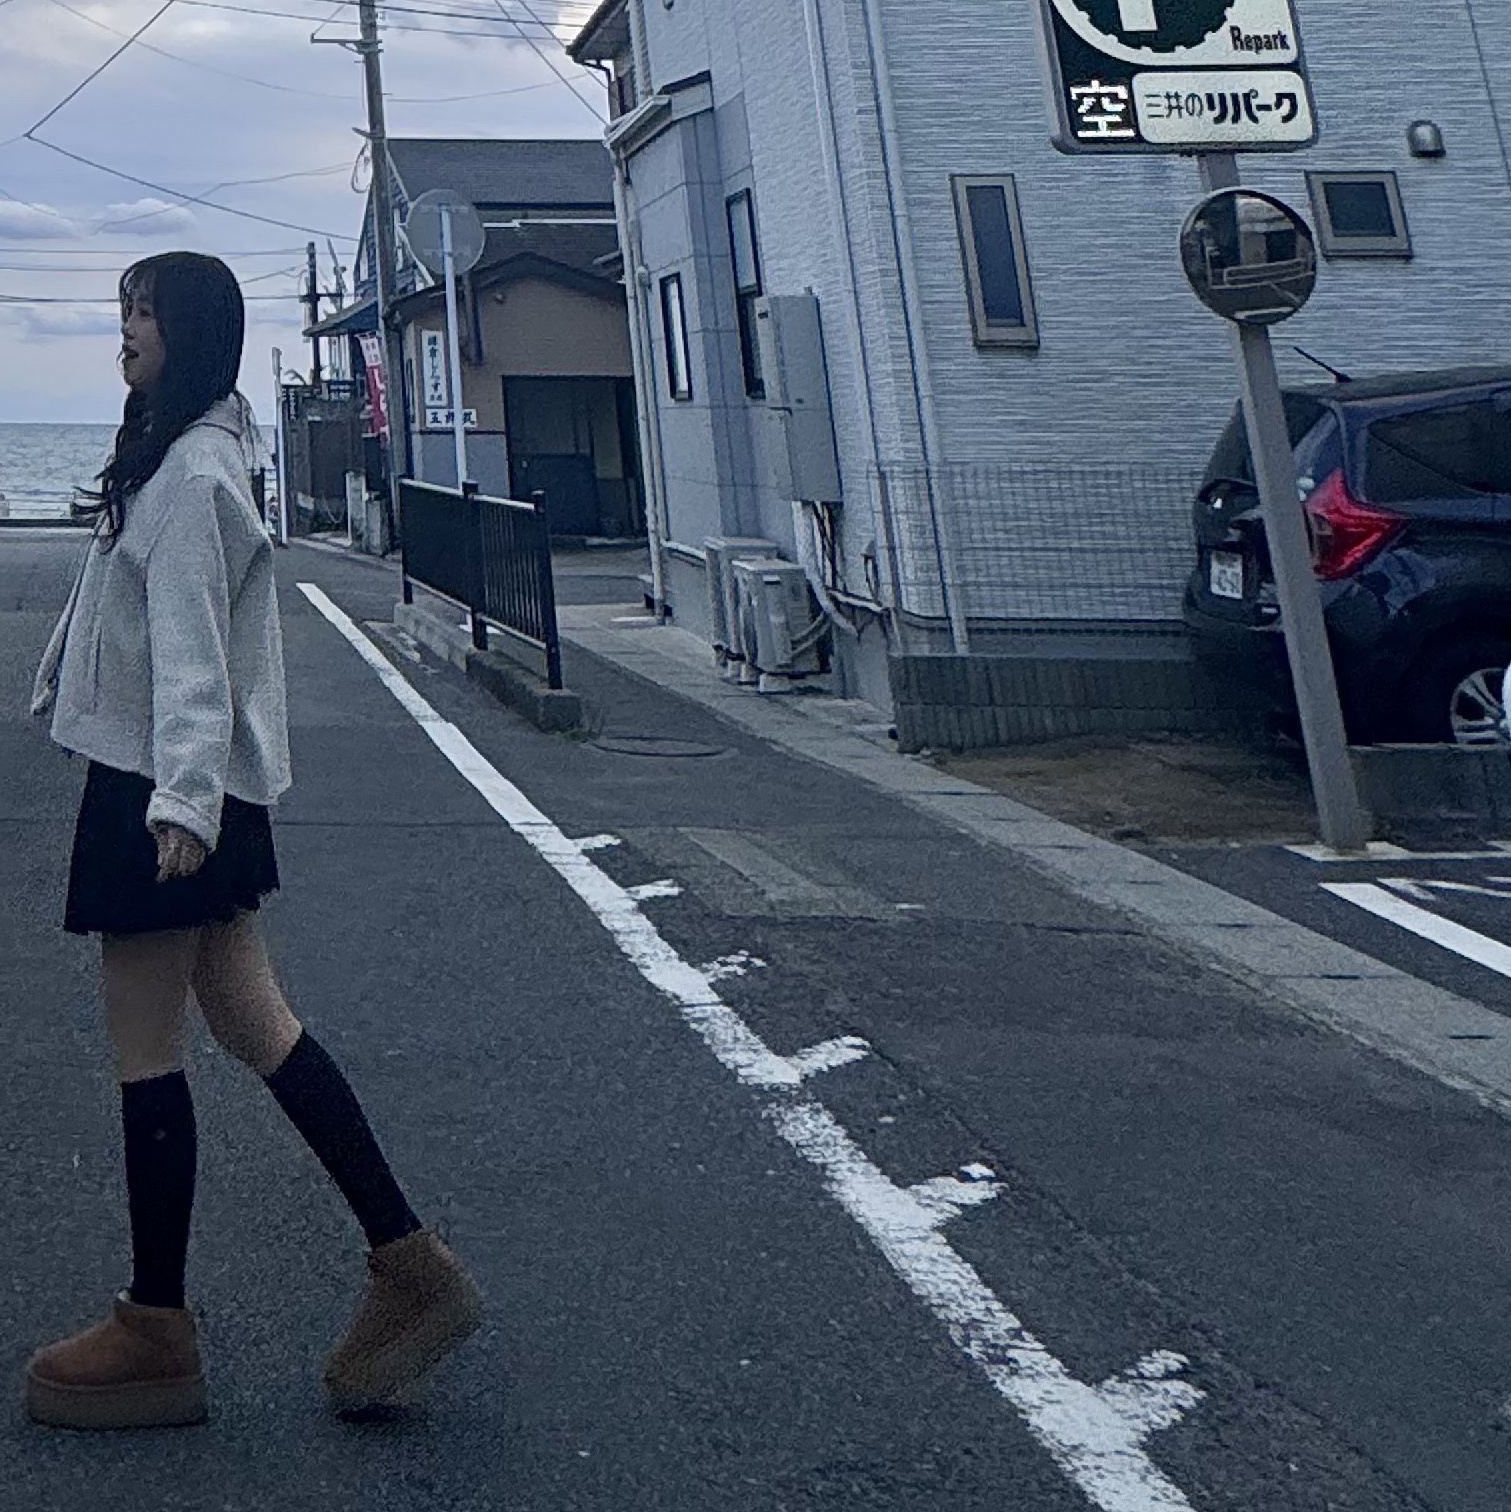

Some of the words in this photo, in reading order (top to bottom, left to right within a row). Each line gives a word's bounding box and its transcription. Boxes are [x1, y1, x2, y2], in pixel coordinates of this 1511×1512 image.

[1229, 25, 1290, 55] Repark
[1070, 80, 1135, 137] 空
[1144, 88, 1298, 125] 三井のリパーク
